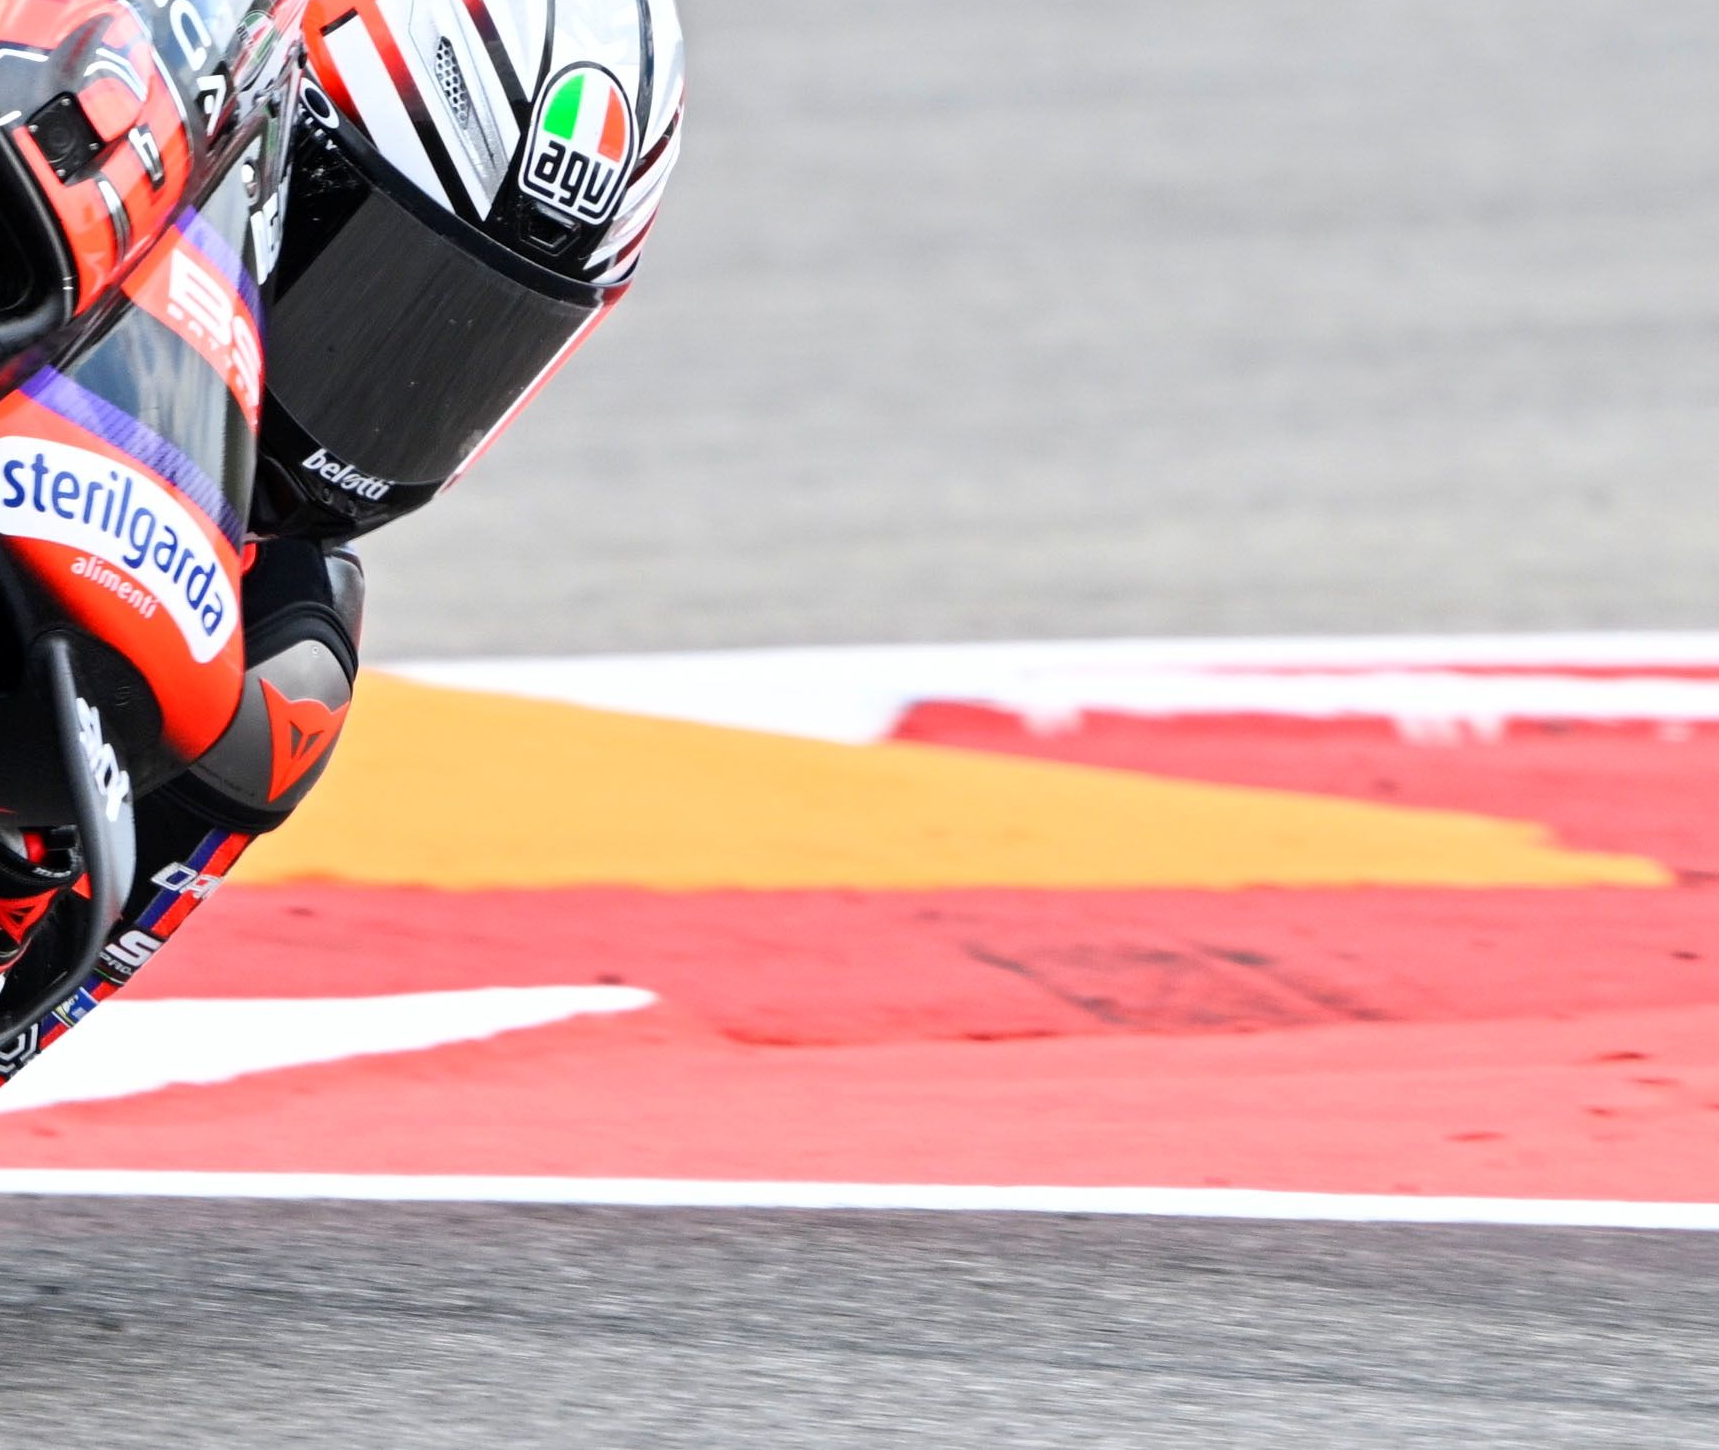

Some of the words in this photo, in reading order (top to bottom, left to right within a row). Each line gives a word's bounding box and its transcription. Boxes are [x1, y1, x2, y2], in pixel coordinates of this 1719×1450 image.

[533, 139, 615, 208] agv
[1, 452, 225, 637] sterilgarda
[70, 555, 160, 620] alimenti
